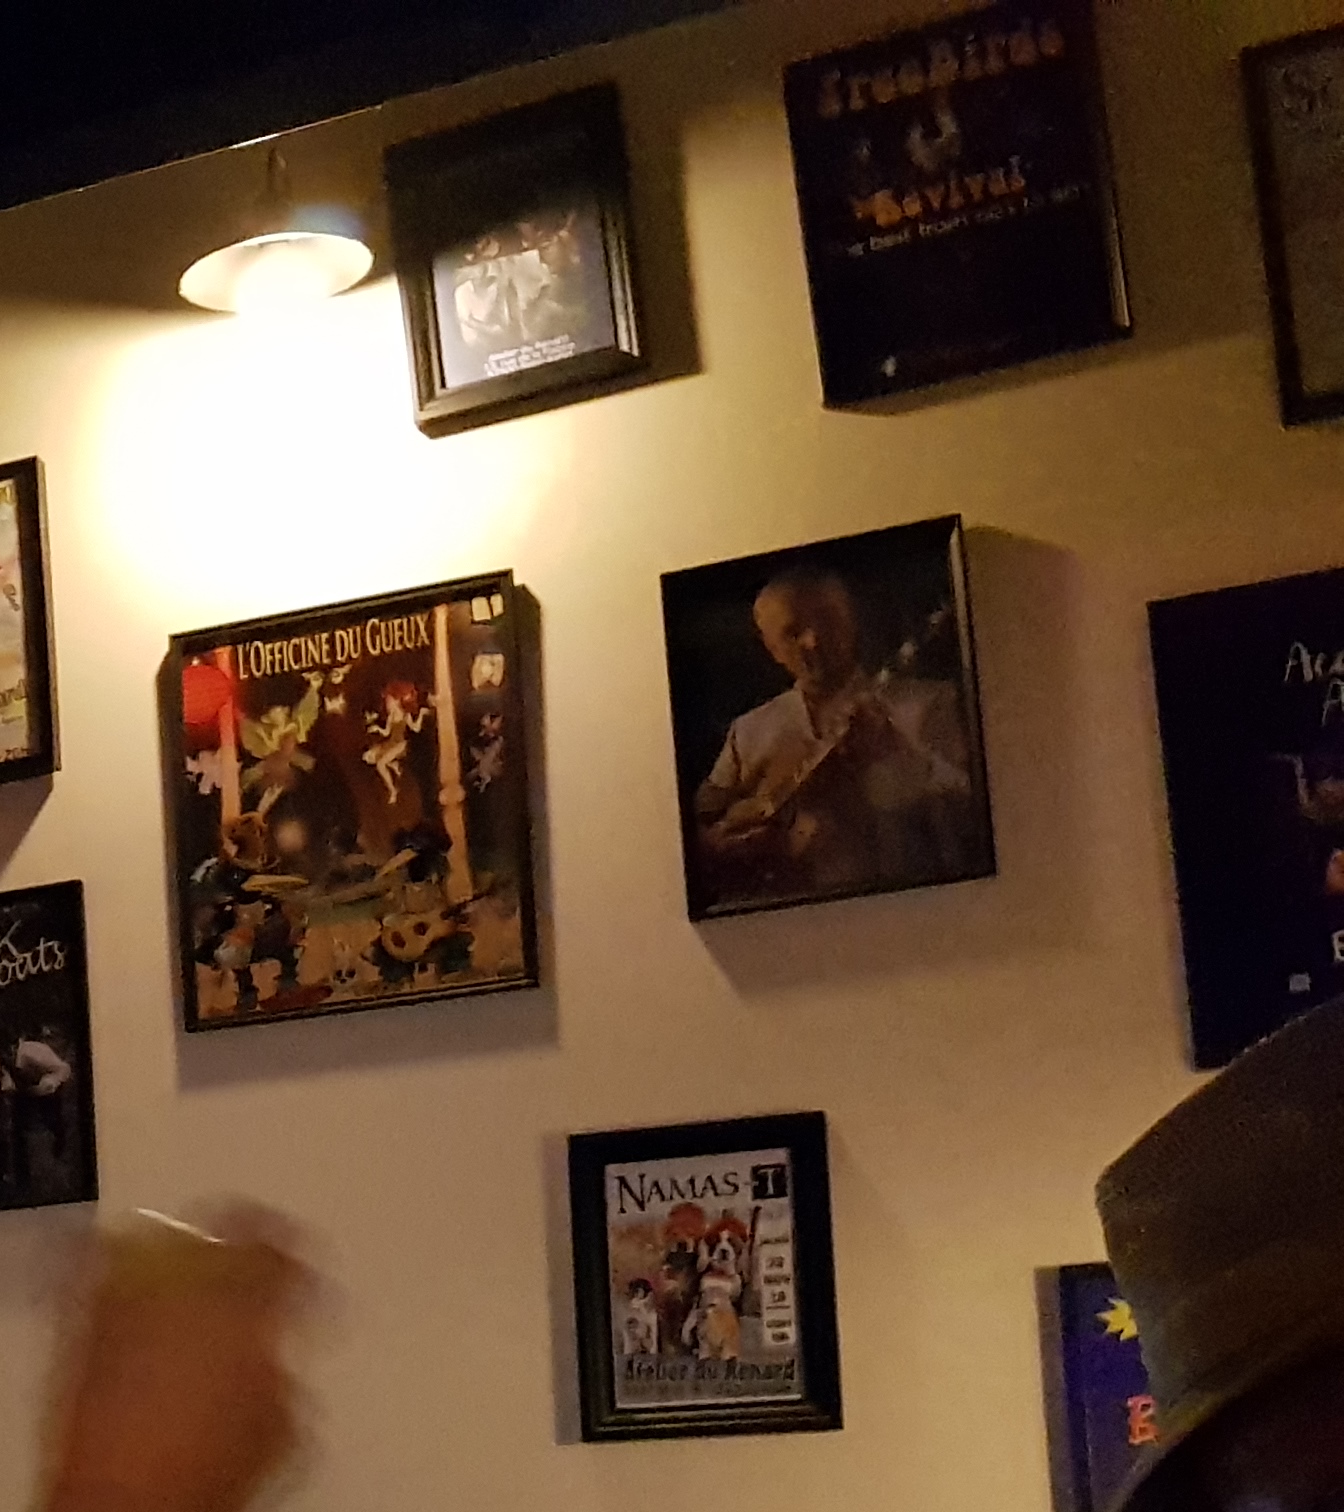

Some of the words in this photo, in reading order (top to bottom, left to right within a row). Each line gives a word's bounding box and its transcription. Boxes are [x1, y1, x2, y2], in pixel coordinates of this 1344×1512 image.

[236, 632, 332, 680] L'OFFICINE
[334, 625, 362, 662] DU
[365, 612, 431, 656] GUEUX
[615, 1172, 740, 1214] NAMAS
